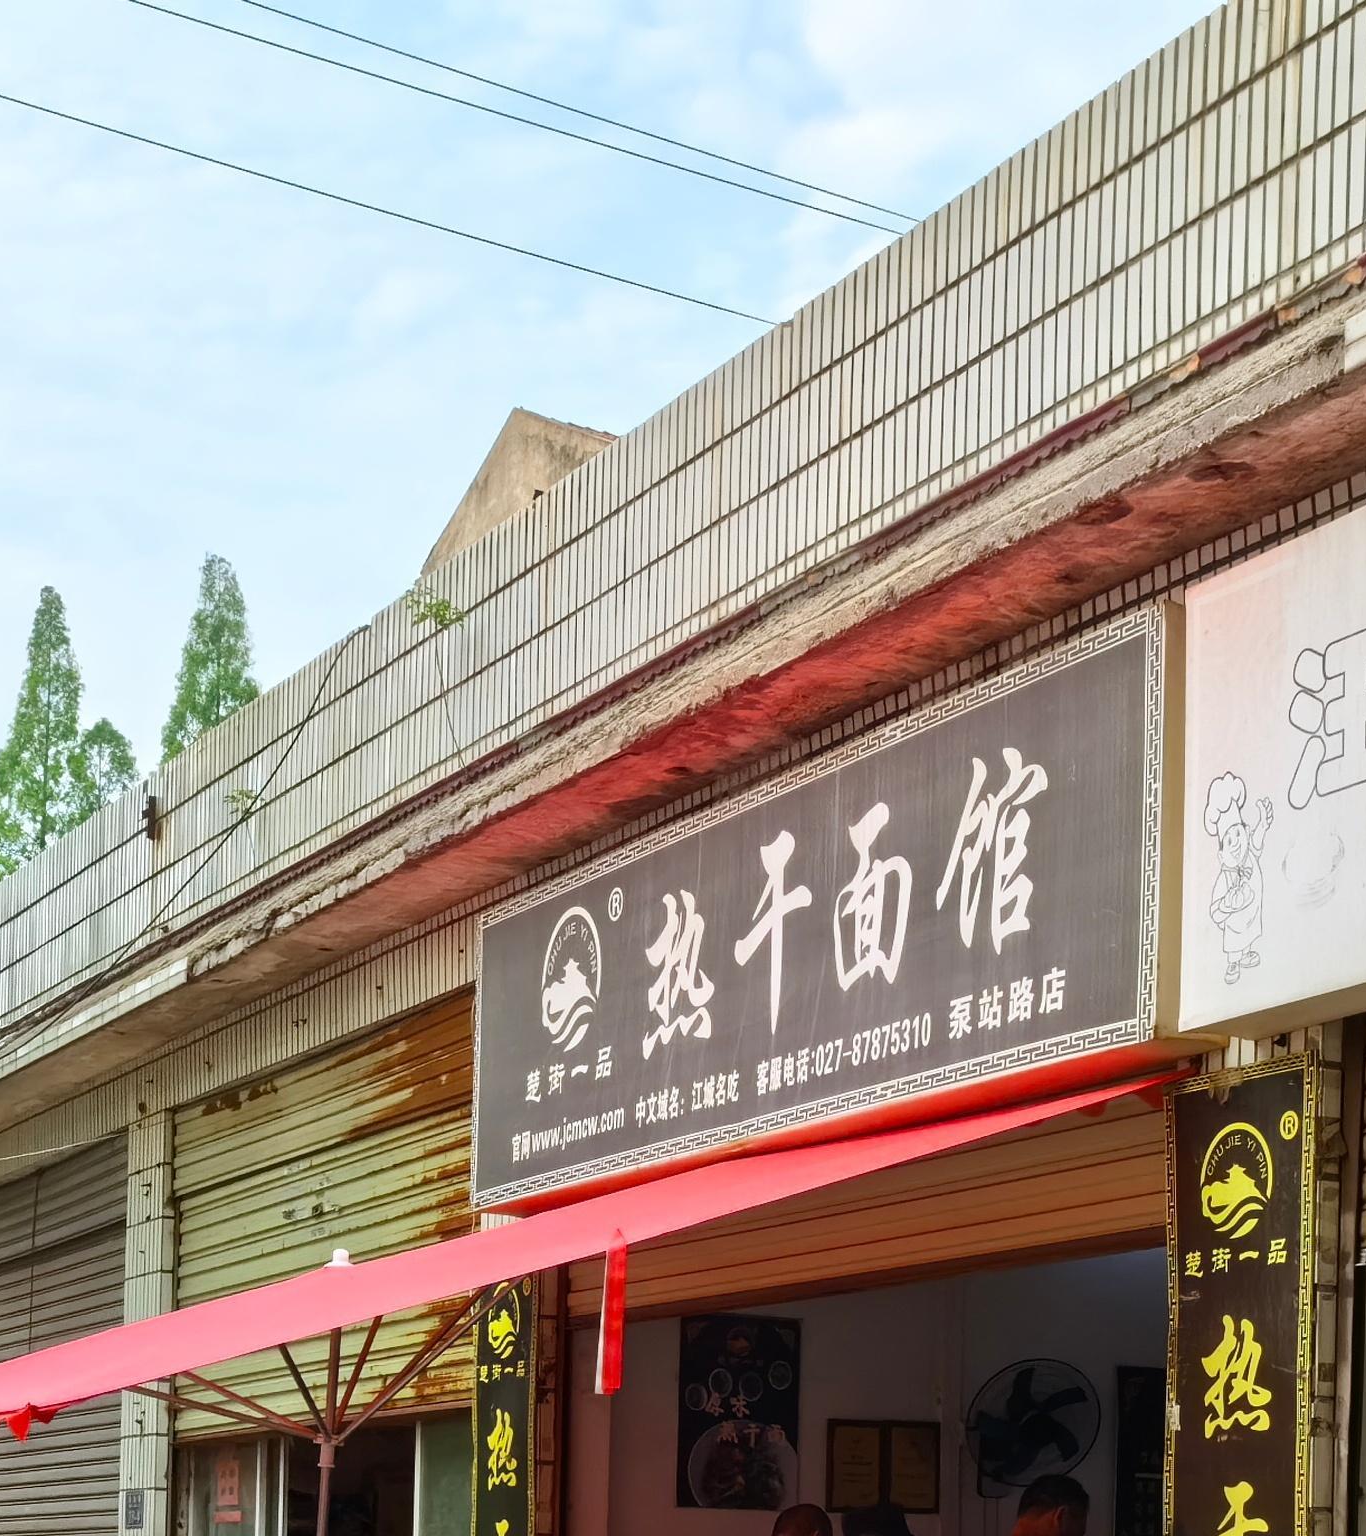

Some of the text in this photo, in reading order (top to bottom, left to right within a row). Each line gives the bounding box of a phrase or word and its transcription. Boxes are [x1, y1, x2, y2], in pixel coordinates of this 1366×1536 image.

[642, 746, 1050, 1061] 热干面馆
[547, 921, 598, 976] CHU JIE YI PIN
[948, 967, 1066, 1041] 泵站路店
[524, 1045, 613, 1103] 楚街一品
[1206, 1134, 1268, 1180] CHU JIE YI PIN
[1184, 1237, 1288, 1278] 楚街一品
